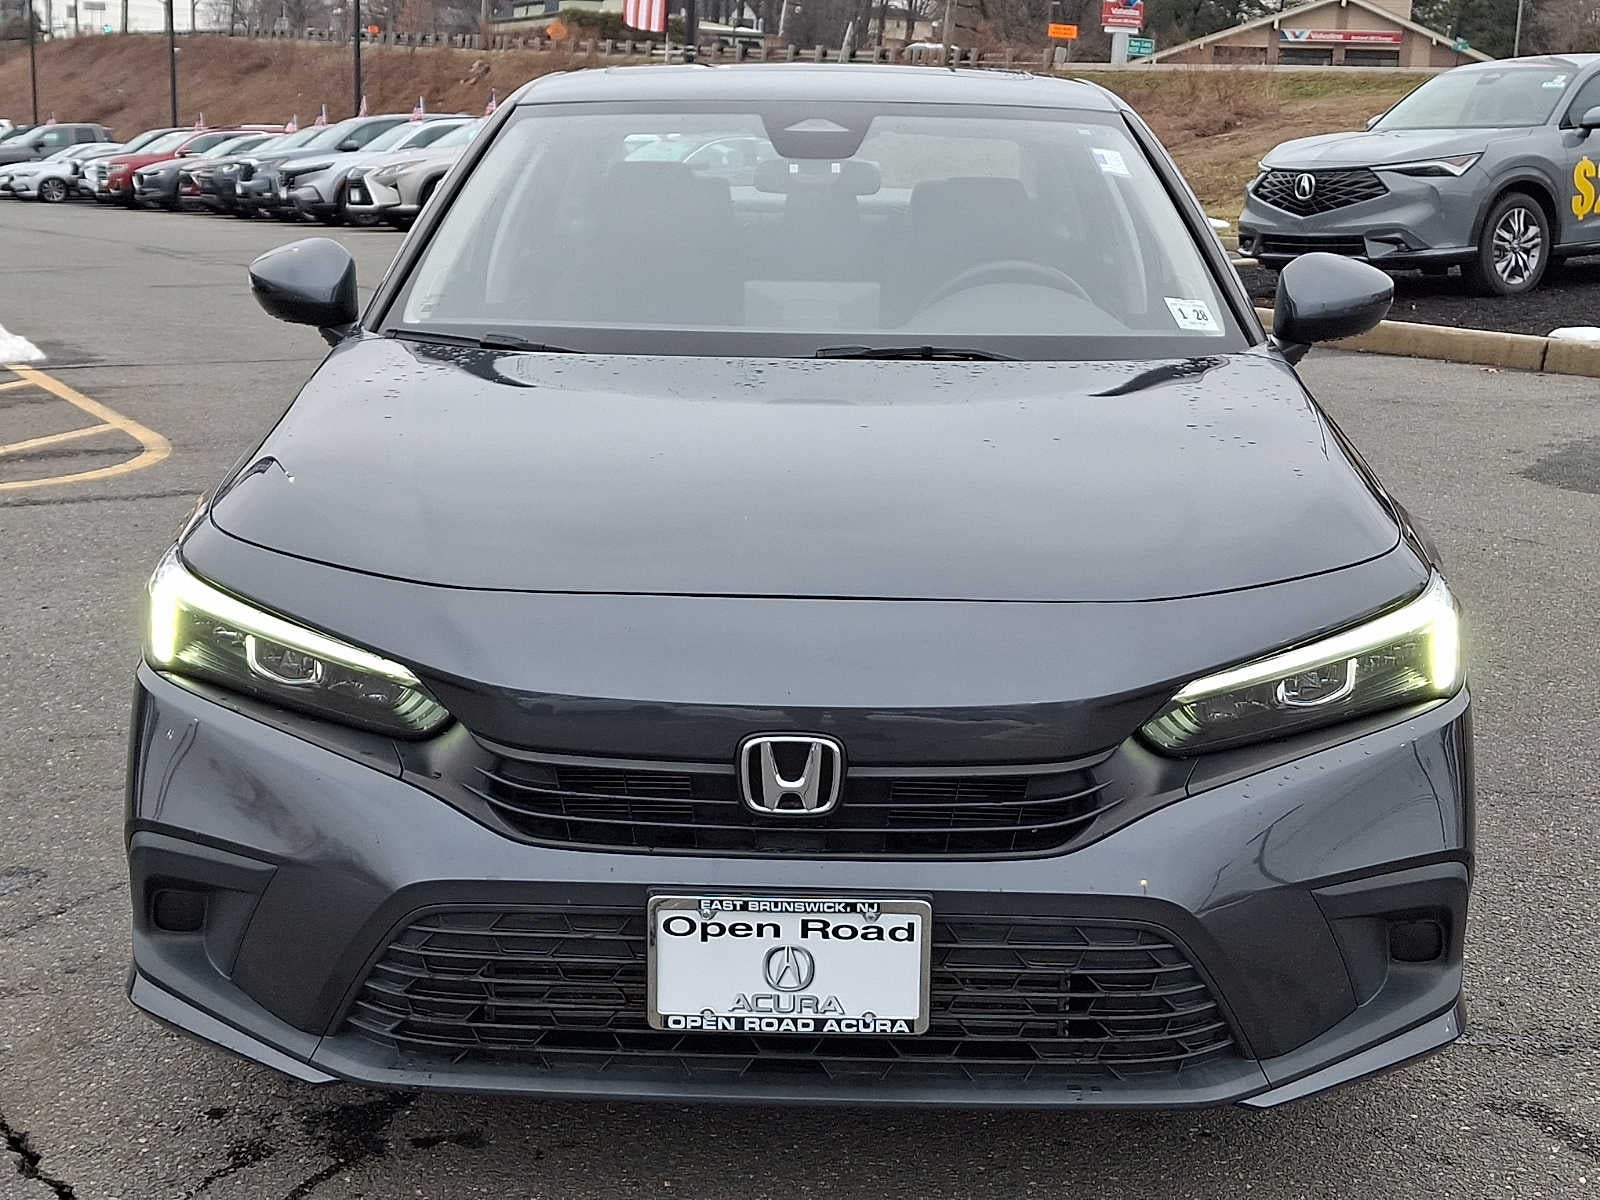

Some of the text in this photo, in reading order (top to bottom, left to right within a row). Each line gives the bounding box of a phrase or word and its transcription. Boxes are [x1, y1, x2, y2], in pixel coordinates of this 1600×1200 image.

[1178, 308, 1208, 321] 1 28
[700, 900, 743, 912] EAST
[856, 902, 879, 913] NJ
[662, 915, 915, 943] Open Road
[727, 993, 845, 1015] ACURA
[667, 1015, 910, 1033] OPEN ROAD ACURA
